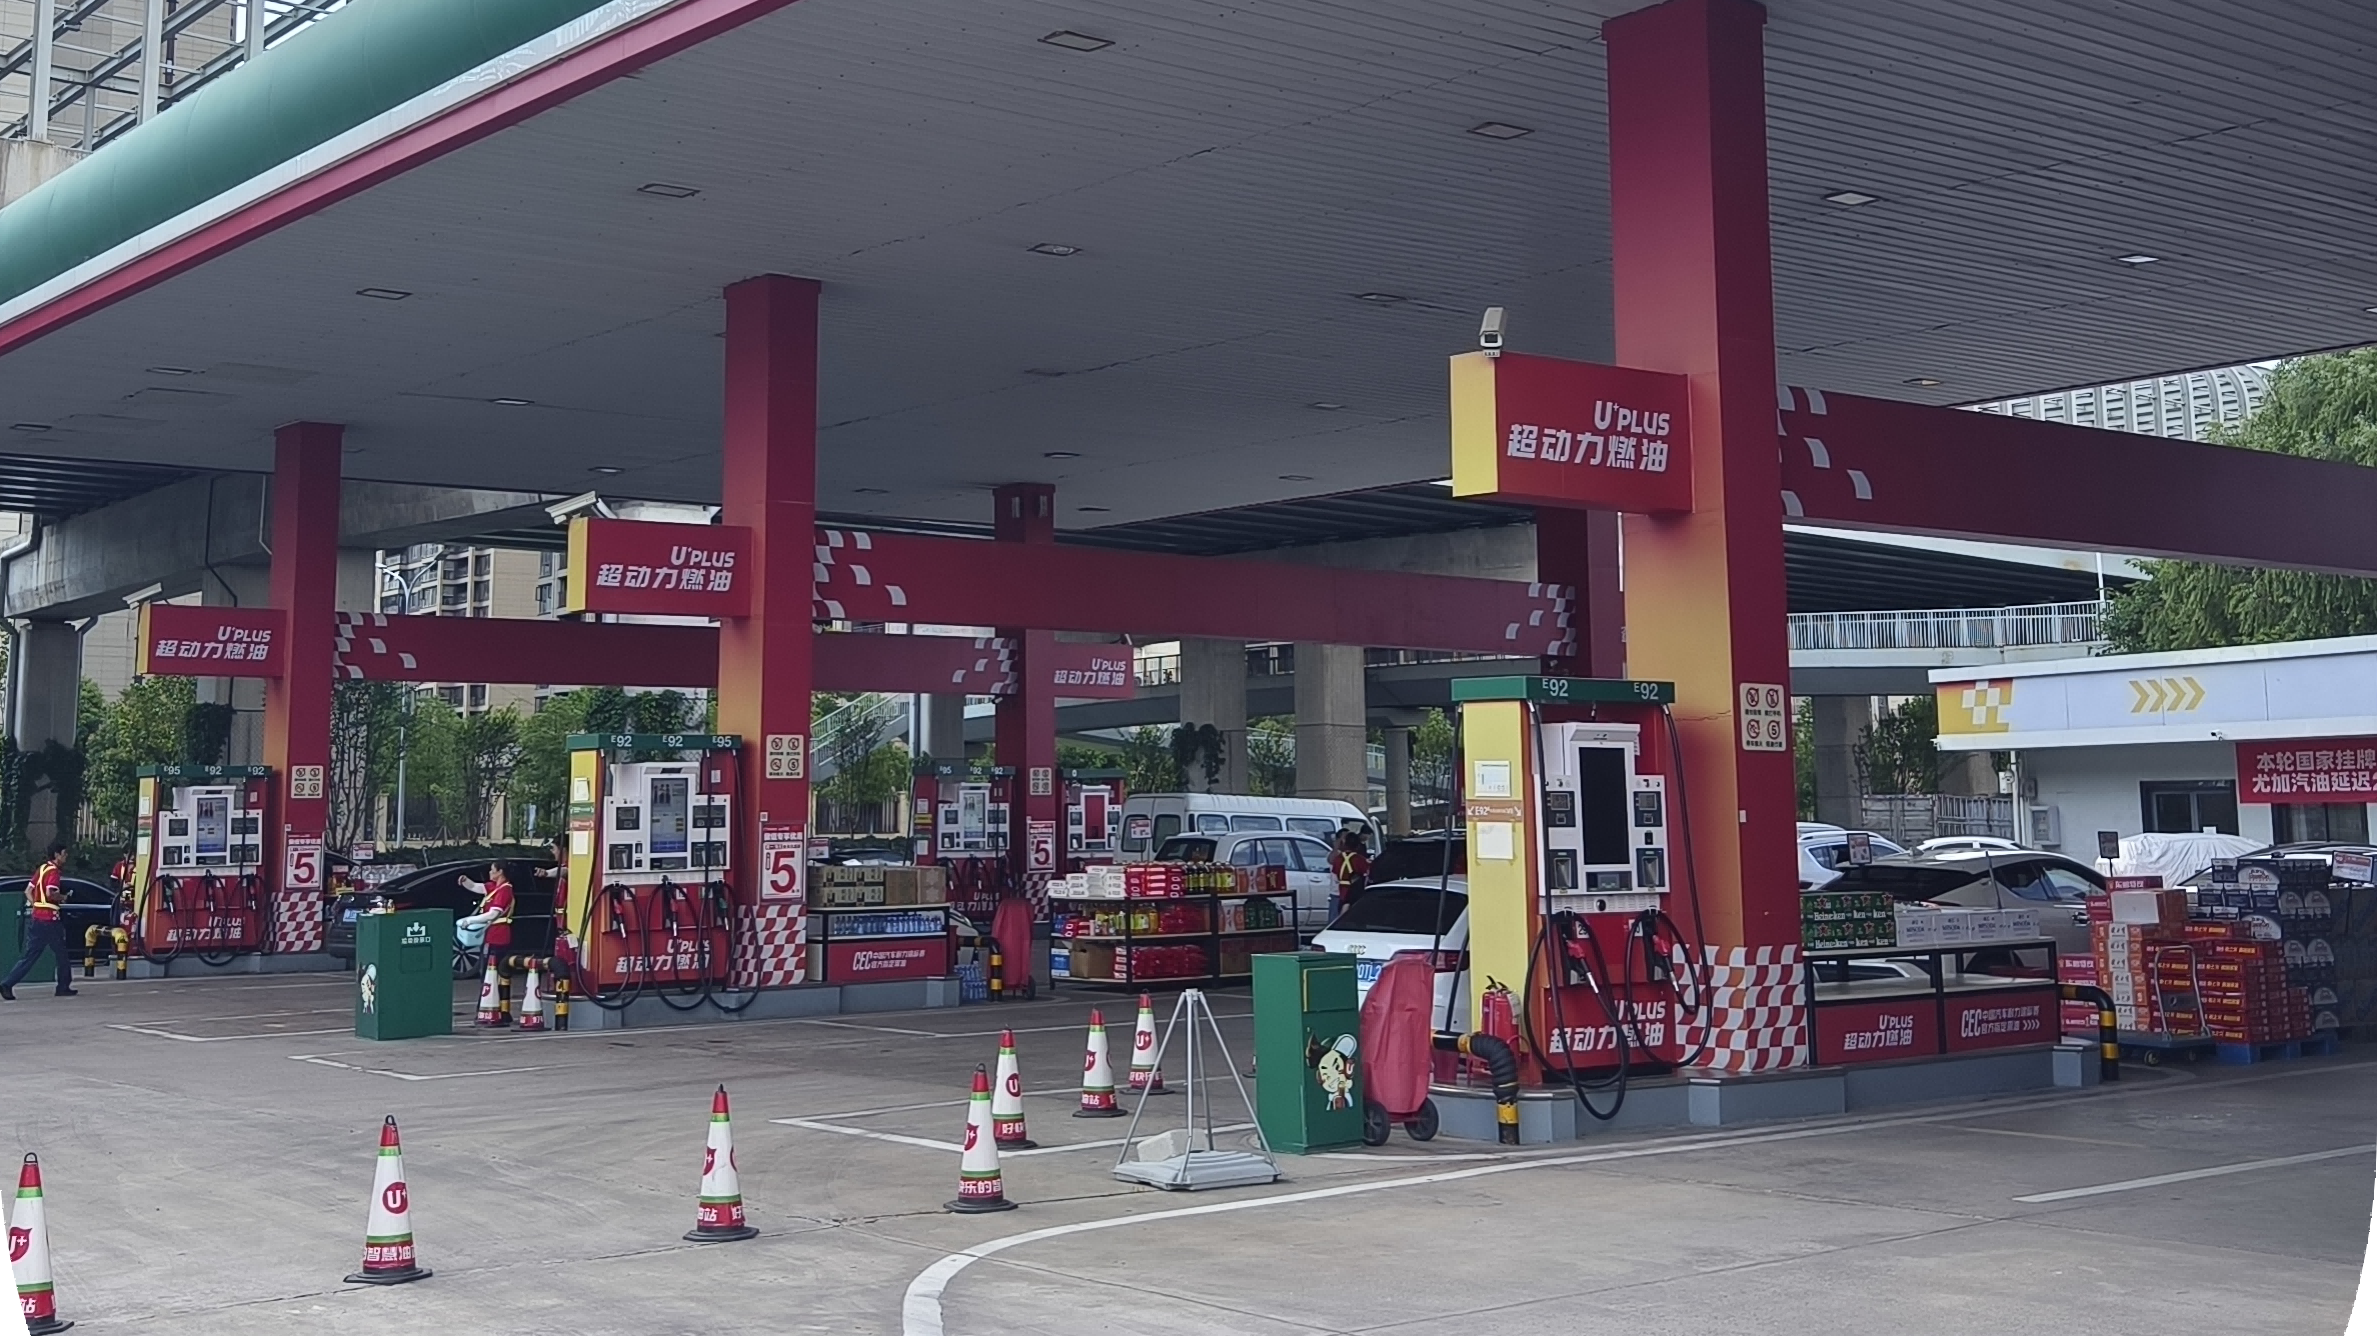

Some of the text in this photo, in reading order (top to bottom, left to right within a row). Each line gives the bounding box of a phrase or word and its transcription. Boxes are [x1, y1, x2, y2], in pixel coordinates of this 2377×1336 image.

[1507, 424, 1668, 472] 超动力燃油
[596, 564, 732, 591] 超动力燃油
[155, 640, 268, 660] 超动力燃油
[1054, 670, 1125, 685] 超动力燃油
[1542, 678, 1569, 697] E92
[1633, 682, 1659, 700] E92
[611, 735, 632, 747] E92
[662, 735, 684, 747] E92
[2256, 749, 2377, 772] 本轮国家挂牌
[1034, 840, 1050, 865] 5
[293, 852, 315, 883] 5
[770, 851, 796, 893] 5
[853, 951, 873, 970] CEC
[1961, 1009, 1982, 1037] CEC
[1844, 1029, 1912, 1050] 超动力燃油
